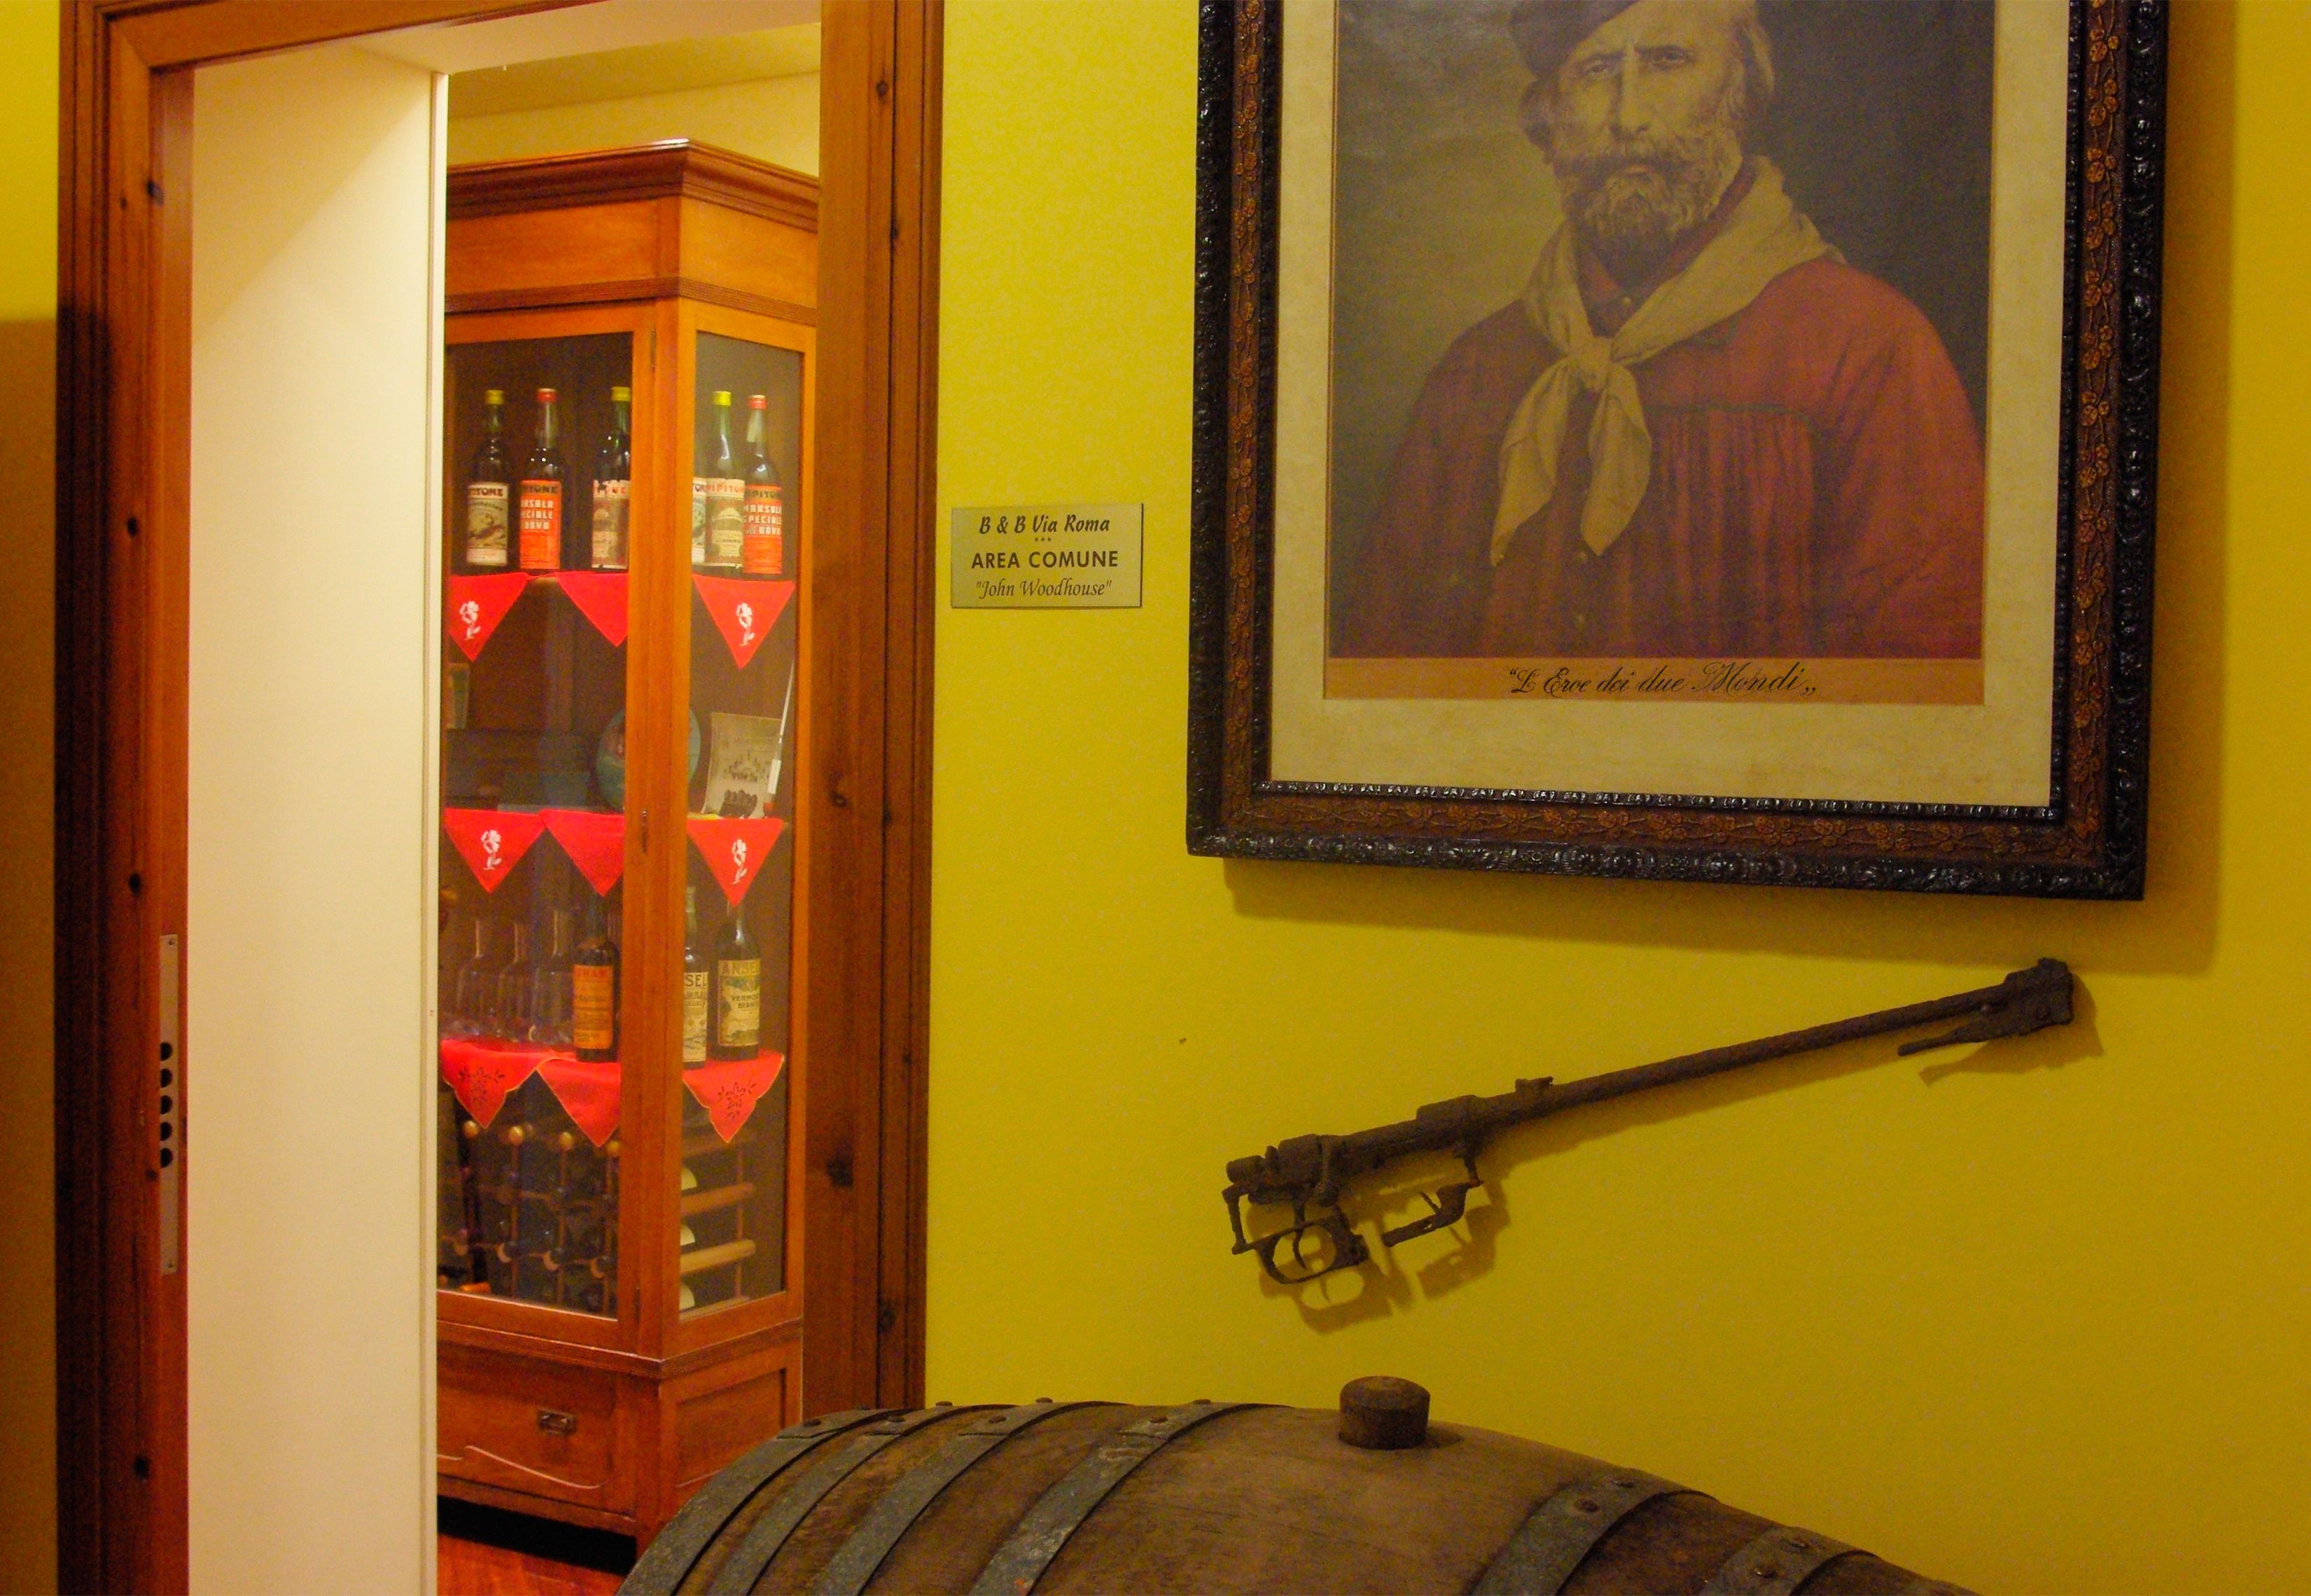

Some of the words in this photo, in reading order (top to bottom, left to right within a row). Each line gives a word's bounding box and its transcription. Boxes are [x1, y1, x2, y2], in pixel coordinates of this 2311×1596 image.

[979, 516, 991, 534] B
[996, 516, 1009, 534] &
[1014, 515, 1026, 533] B
[1032, 514, 1057, 533] Via
[1064, 514, 1110, 532] Roma
[971, 552, 1020, 568] AREA
[1028, 550, 1118, 568] COMUNE
[976, 578, 1014, 599] "John
[1019, 578, 1112, 596] Woodhouse"
[1597, 667, 1634, 693] dei
[1636, 665, 1688, 693] due
